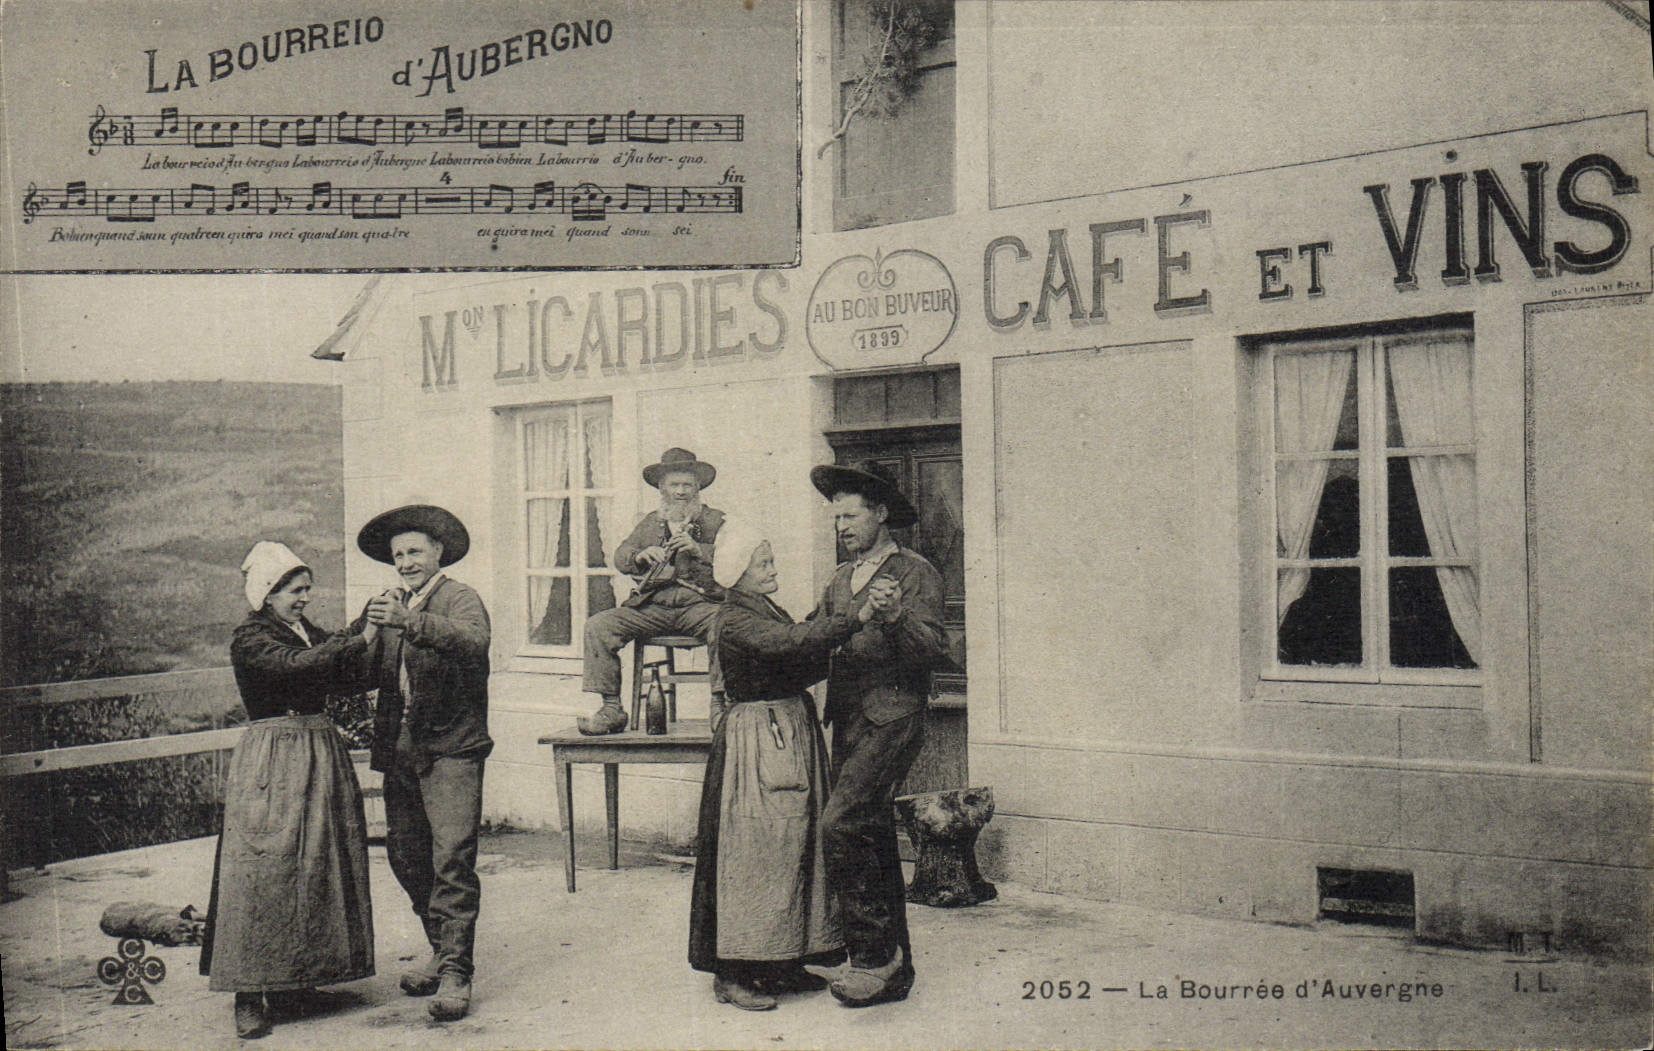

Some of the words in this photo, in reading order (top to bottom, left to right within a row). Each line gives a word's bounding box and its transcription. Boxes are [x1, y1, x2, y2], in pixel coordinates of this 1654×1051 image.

[983, 194, 1213, 332] CAFÉ
[1256, 241, 1335, 302] ET
[1363, 153, 1641, 290] VINS
[813, 301, 836, 323] AU
[842, 296, 880, 321] BON
[885, 288, 954, 316] BUVEUR
[858, 330, 900, 349] 1899
